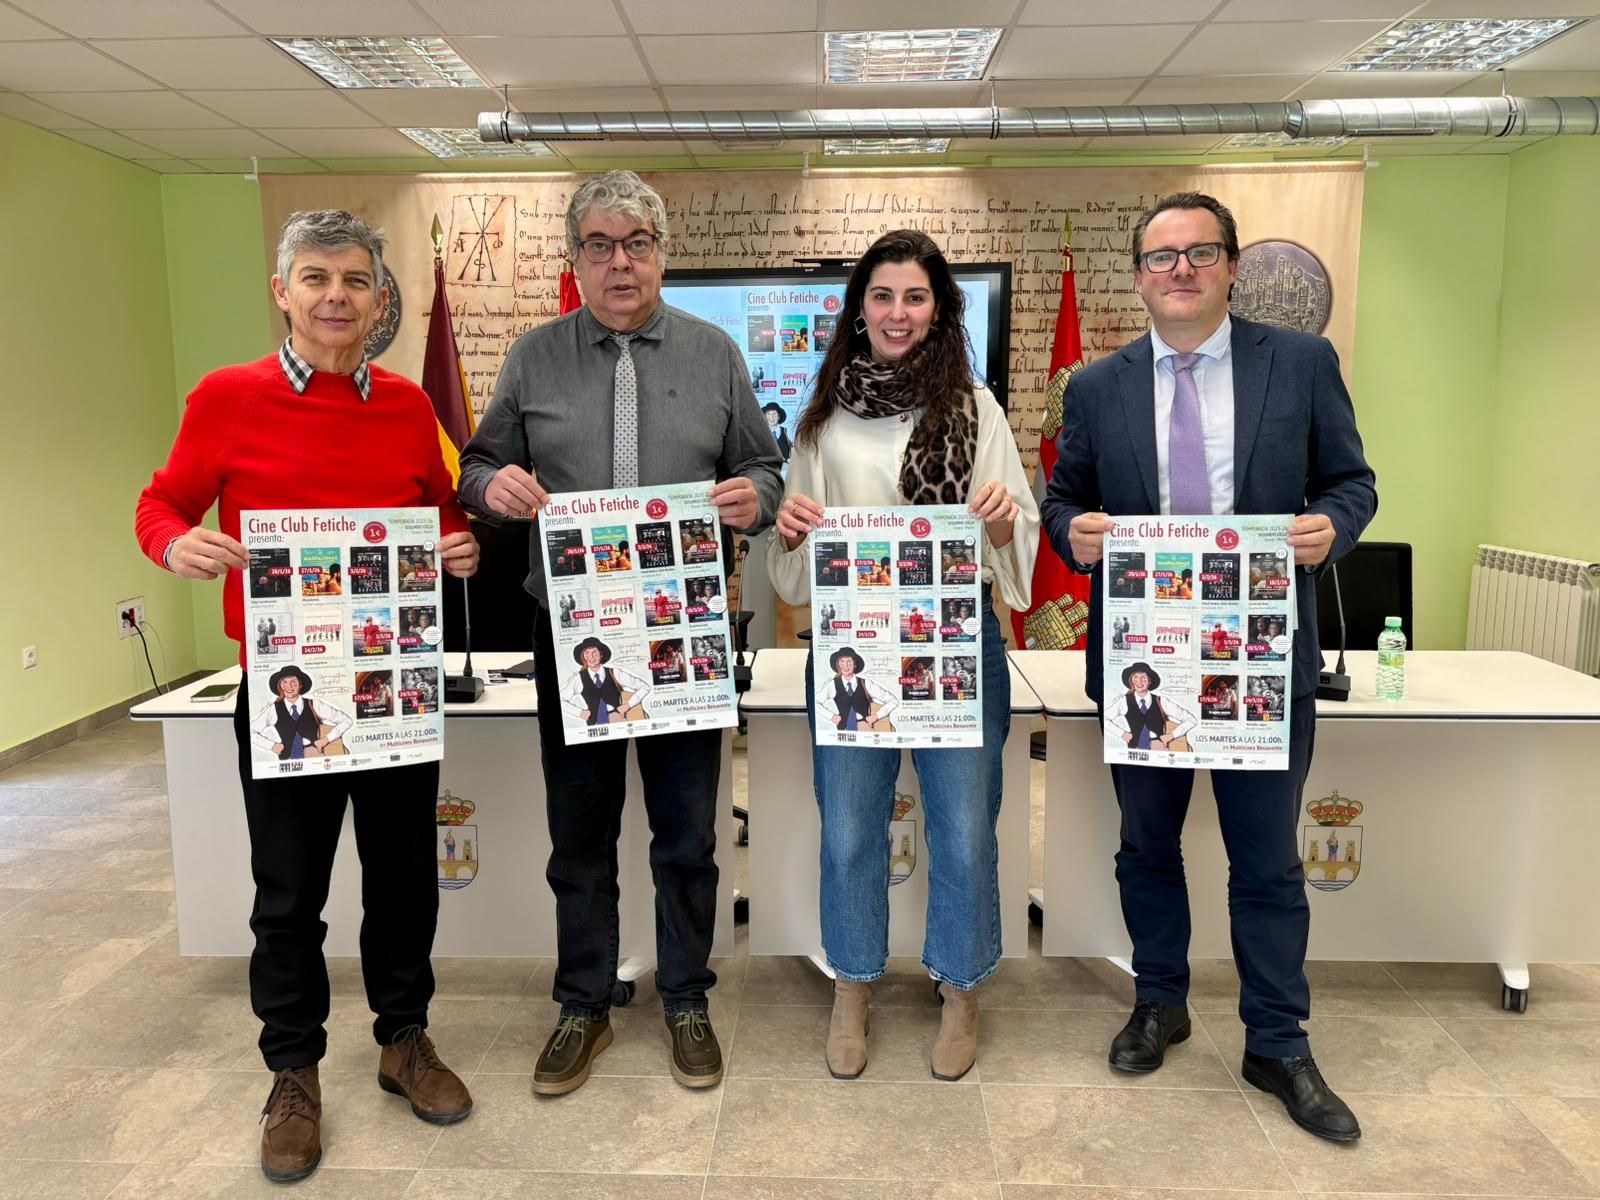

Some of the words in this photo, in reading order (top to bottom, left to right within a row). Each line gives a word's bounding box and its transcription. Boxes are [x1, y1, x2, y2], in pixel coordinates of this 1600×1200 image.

[748, 292, 766, 304] Cine
[768, 291, 787, 304] Club
[790, 290, 819, 304] Fetiche
[544, 502, 568, 517] Cine
[572, 498, 597, 515] Club
[600, 494, 639, 512] Fetiche
[248, 518, 276, 534] Cine
[281, 516, 308, 533] Club
[313, 515, 356, 532] Fetiche
[545, 516, 576, 527] presenta:
[816, 517, 837, 528] ine
[841, 513, 863, 528] Club
[867, 512, 904, 528] Fetiche
[815, 529, 843, 538] presenta:
[1110, 523, 1134, 537] Cine
[1139, 522, 1163, 537] Club
[1169, 522, 1209, 537] Fetiche
[248, 534, 285, 545] presenta:
[663, 697, 688, 706] MARTES
[366, 732, 393, 741] MARTES
[386, 739, 412, 747] Multicines
[413, 736, 437, 744] Benavente
